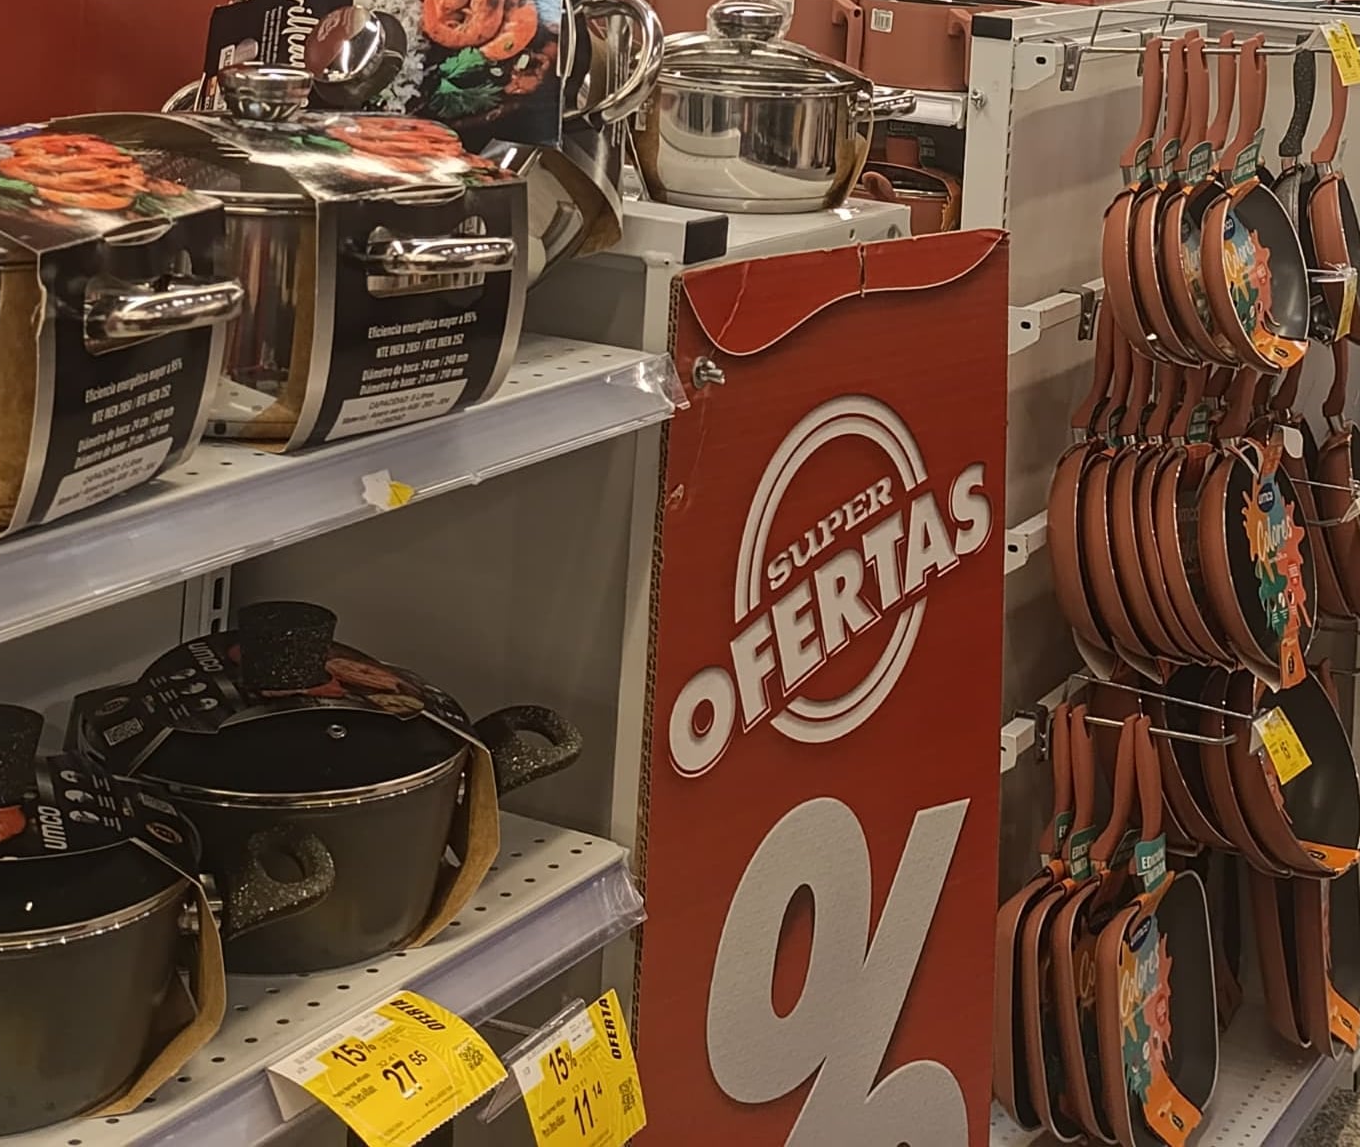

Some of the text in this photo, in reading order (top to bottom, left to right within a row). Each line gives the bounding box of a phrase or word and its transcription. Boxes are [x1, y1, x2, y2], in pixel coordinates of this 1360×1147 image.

[367, 324, 402, 339] Eficiencia
[401, 318, 438, 334] energética
[766, 474, 894, 592] SUPER
[668, 460, 994, 779] OFERTAS
[187, 641, 224, 672] umco
[41, 805, 68, 850] umco
[389, 999, 447, 1031] OFERTA
[598, 998, 623, 1060] OFERTA
[330, 1040, 377, 1067] 15%
[408, 1050, 428, 1066] 55
[549, 1046, 578, 1085] 15%
[382, 1059, 420, 1094] 27
[592, 1080, 603, 1100] 14
[573, 1088, 595, 1136] 11
